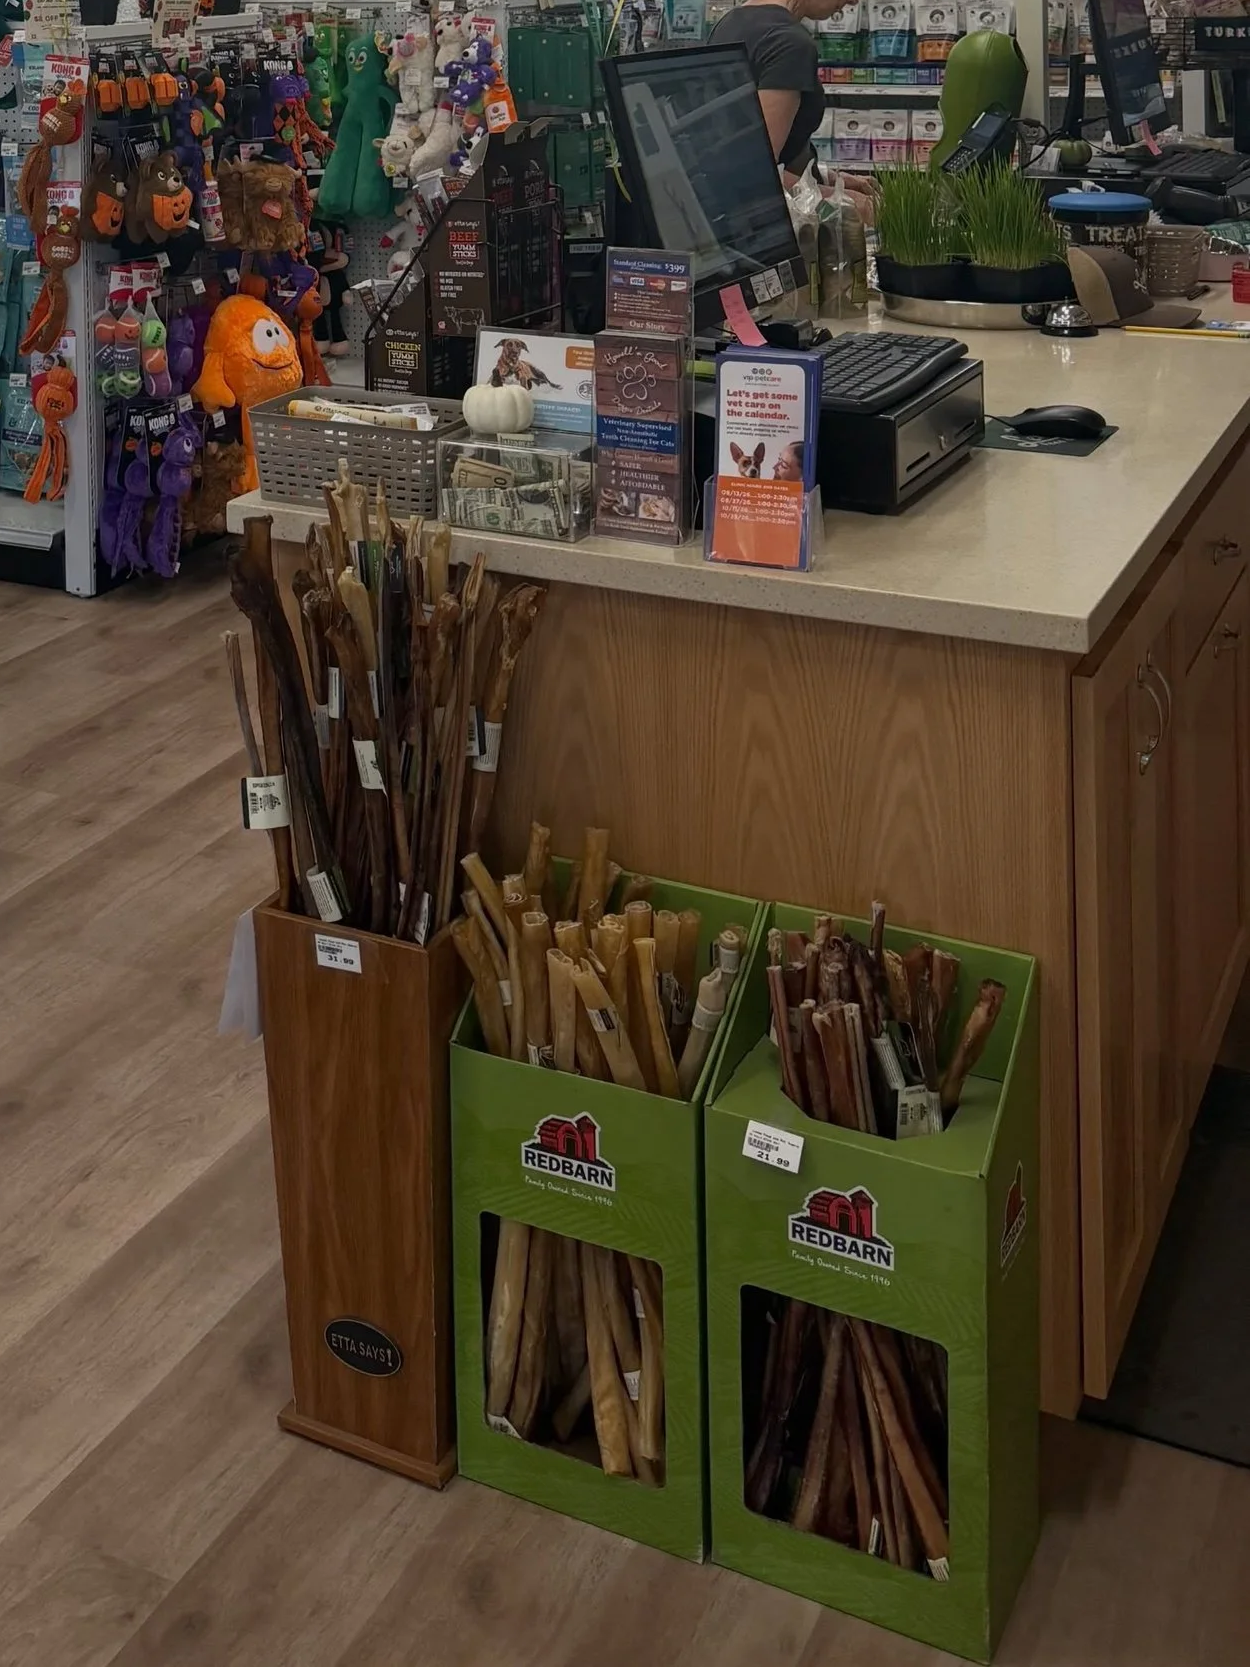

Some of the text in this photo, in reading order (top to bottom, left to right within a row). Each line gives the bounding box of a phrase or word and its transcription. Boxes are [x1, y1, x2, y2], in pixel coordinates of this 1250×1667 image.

[1204, 26, 1250, 38] TURK
[51, 62, 75, 76] KONG
[263, 60, 288, 71] KONG
[449, 231, 480, 242] BEEF
[452, 243, 476, 251] YUMM
[452, 250, 477, 258] STICKS
[630, 320, 666, 331] Our Story
[385, 341, 421, 352] CHICKEN
[391, 352, 415, 360] YUMM
[391, 359, 416, 367] STICKS
[727, 389, 750, 398] Let's
[752, 392, 769, 400] get
[727, 409, 790, 420] the calendar.
[149, 416, 168, 430] KONG
[603, 418, 672, 431] Veterinary Supervised
[620, 434, 648, 444] Cleaning
[620, 462, 642, 470] SAFER
[620, 470, 660, 481] HEALTHIER
[620, 480, 666, 491] AFFORDABLE
[327, 954, 354, 965] 31.99
[757, 1150, 790, 1167] 21.99
[524, 1149, 614, 1188] REDBARN
[525, 1175, 613, 1207] Family Owned Since 1996
[791, 1222, 892, 1267] REDBARN
[791, 1249, 891, 1286] Family Owned Since 1996
[331, 1332, 393, 1367] ETTA SAYS!
